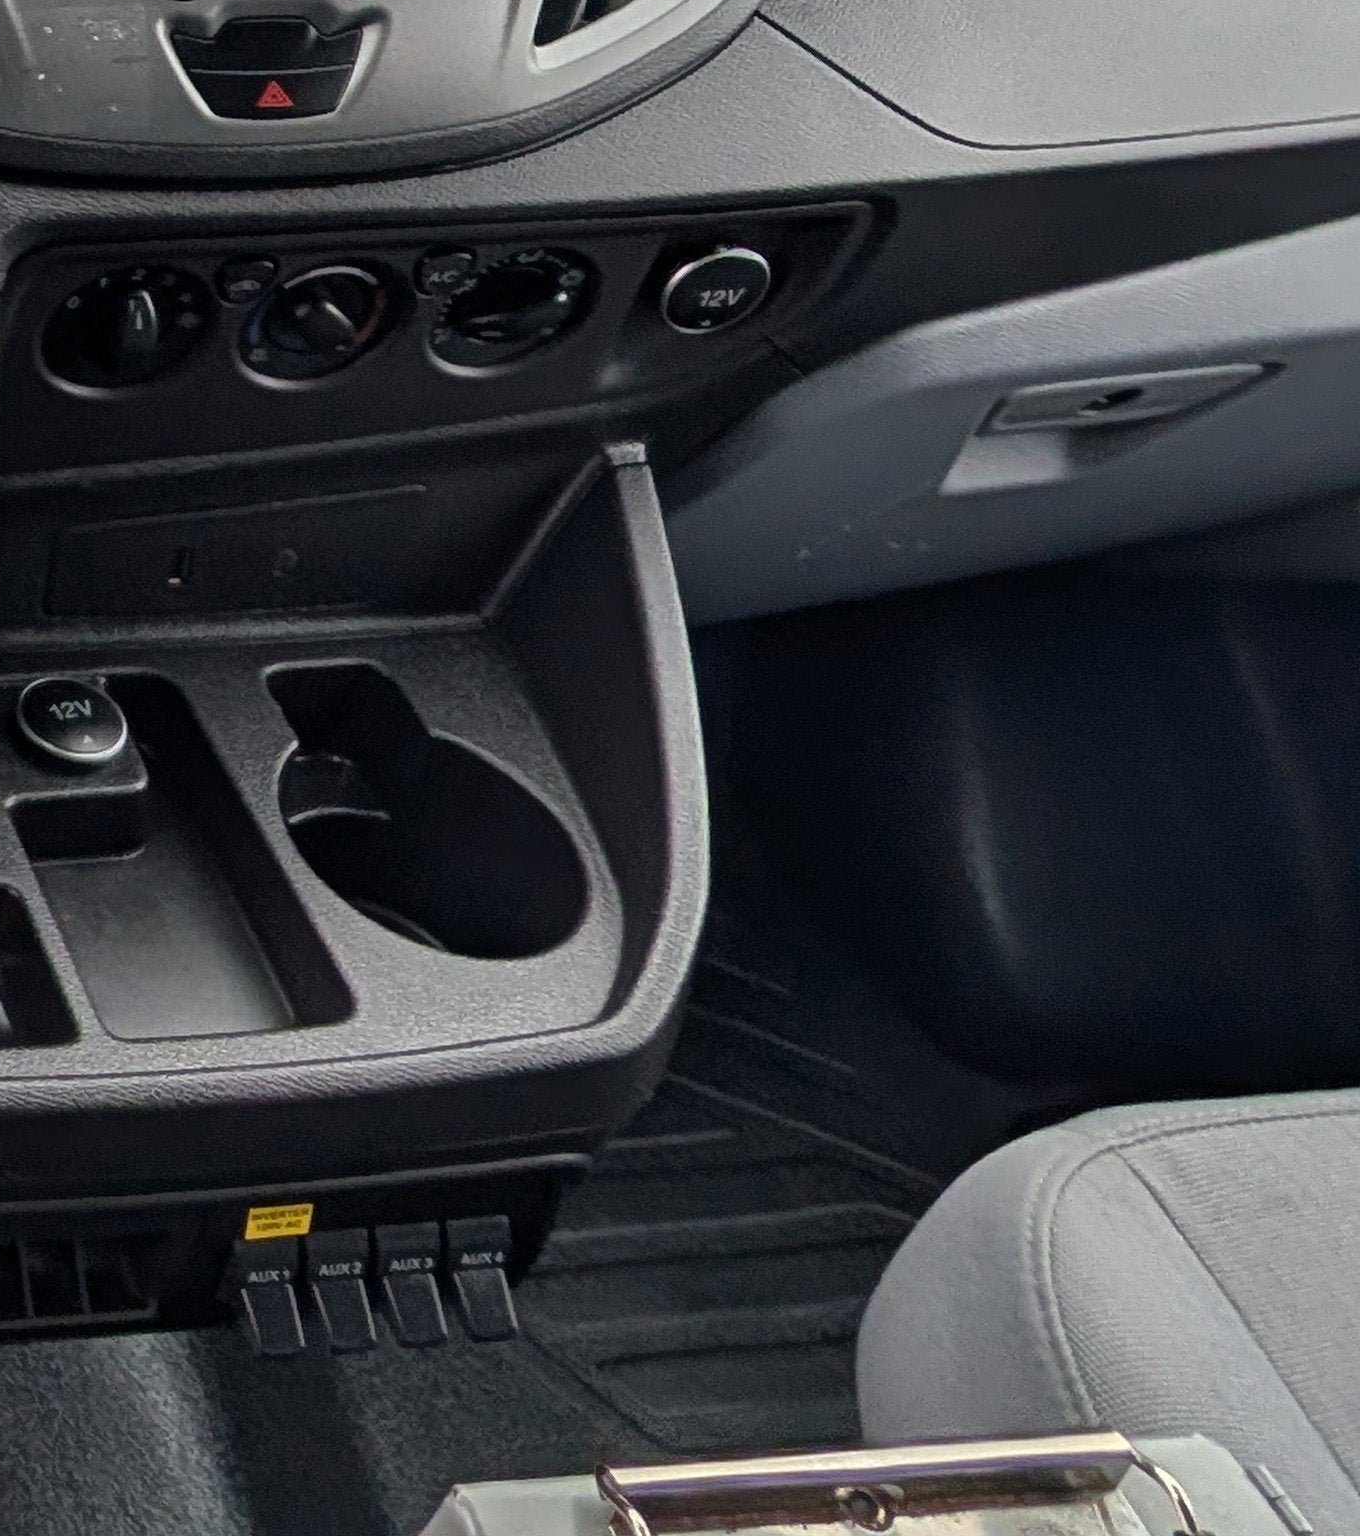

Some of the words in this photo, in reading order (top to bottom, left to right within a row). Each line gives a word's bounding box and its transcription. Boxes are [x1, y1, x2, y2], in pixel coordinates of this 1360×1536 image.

[698, 287, 748, 308] 12V
[49, 699, 93, 721] 12V
[388, 1257, 422, 1272] AUX
[460, 1252, 491, 1265] AUX
[493, 1251, 504, 1264] 4
[247, 1269, 280, 1283] AUX
[318, 1263, 351, 1277] AUX
